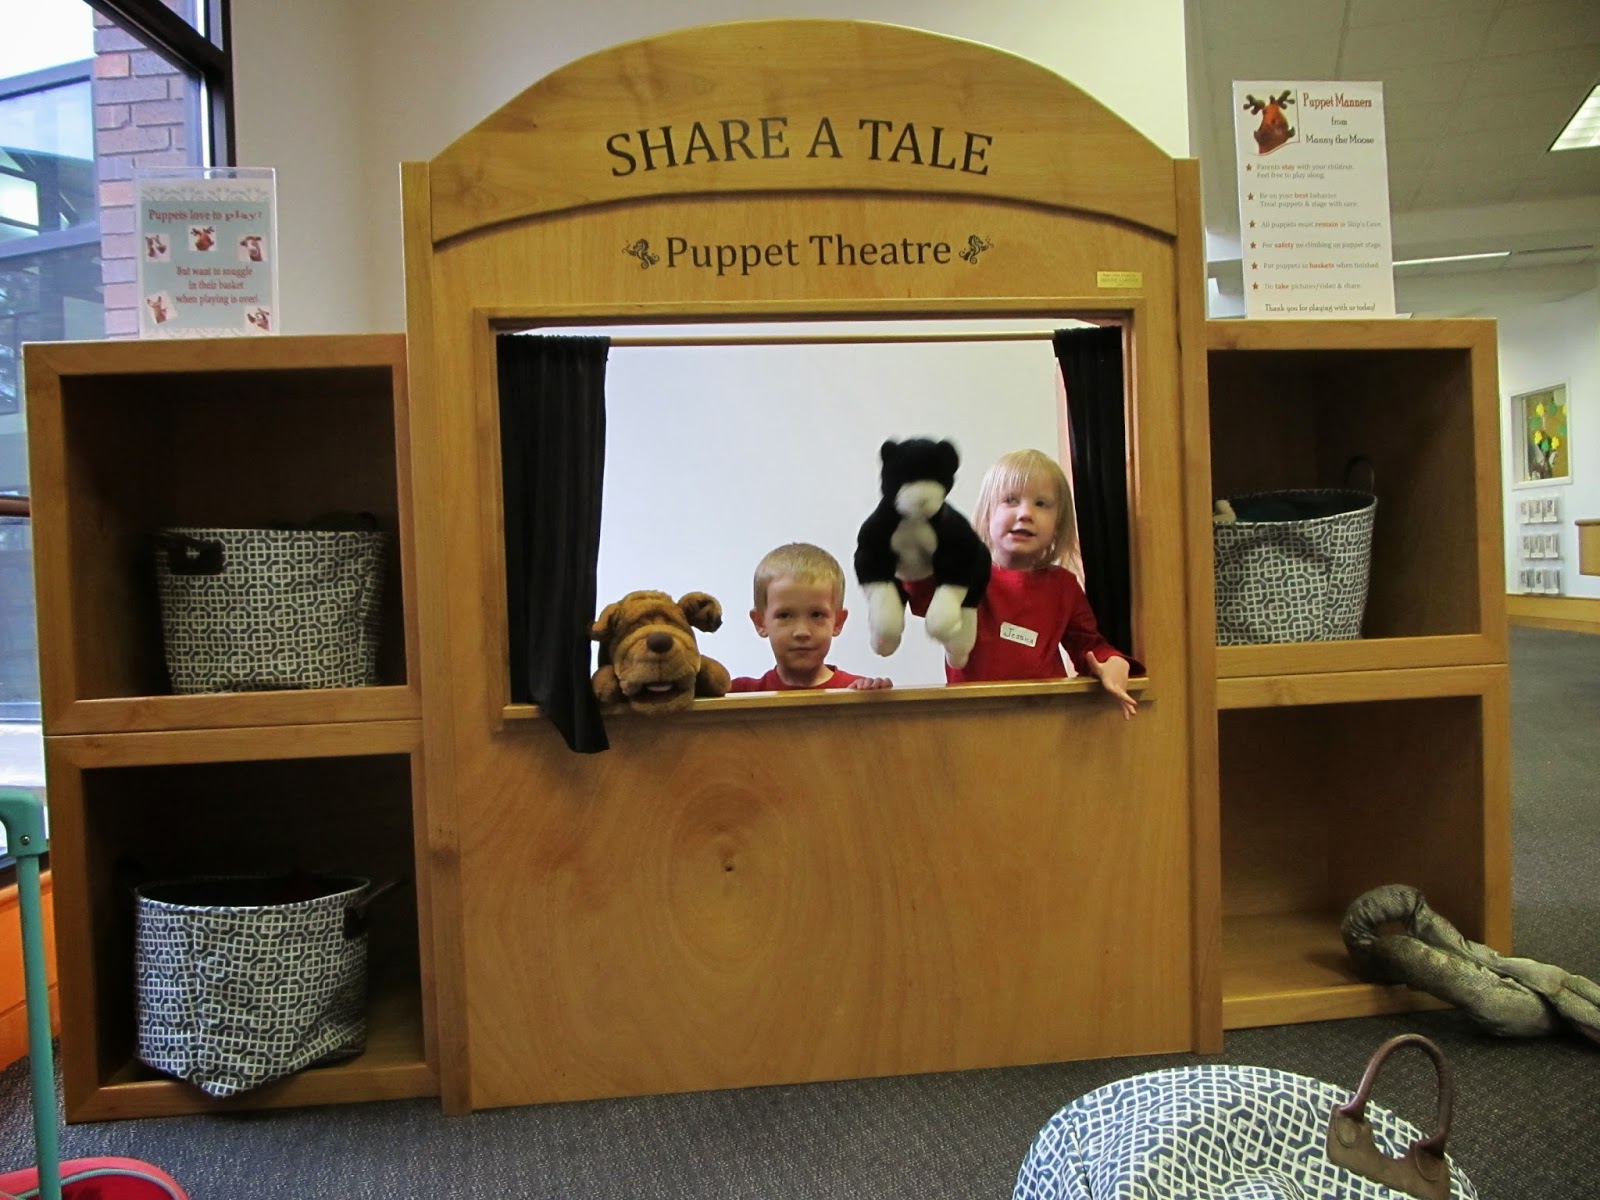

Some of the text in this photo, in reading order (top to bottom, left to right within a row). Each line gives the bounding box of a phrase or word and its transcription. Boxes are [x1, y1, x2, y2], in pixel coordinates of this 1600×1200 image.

[1303, 92, 1372, 110] Puppet Manners
[1331, 116, 1347, 125] from
[1306, 134, 1374, 145] Manny the Moose
[606, 116, 993, 177] SHARE A TALE
[149, 210, 187, 223] Puppets
[190, 210, 209, 220] love
[212, 211, 222, 220] to
[1305, 241, 1331, 249] climbing
[666, 234, 952, 276] Puppet Theatre
[176, 266, 253, 278] But want to snuggle
[189, 281, 244, 290] in their basket
[176, 295, 197, 303] when
[200, 295, 229, 305] playing
[1286, 304, 1297, 312] you
[1309, 304, 1332, 312] playing
[1357, 303, 1375, 312] today!
[1003, 627, 1034, 644] Jessica
